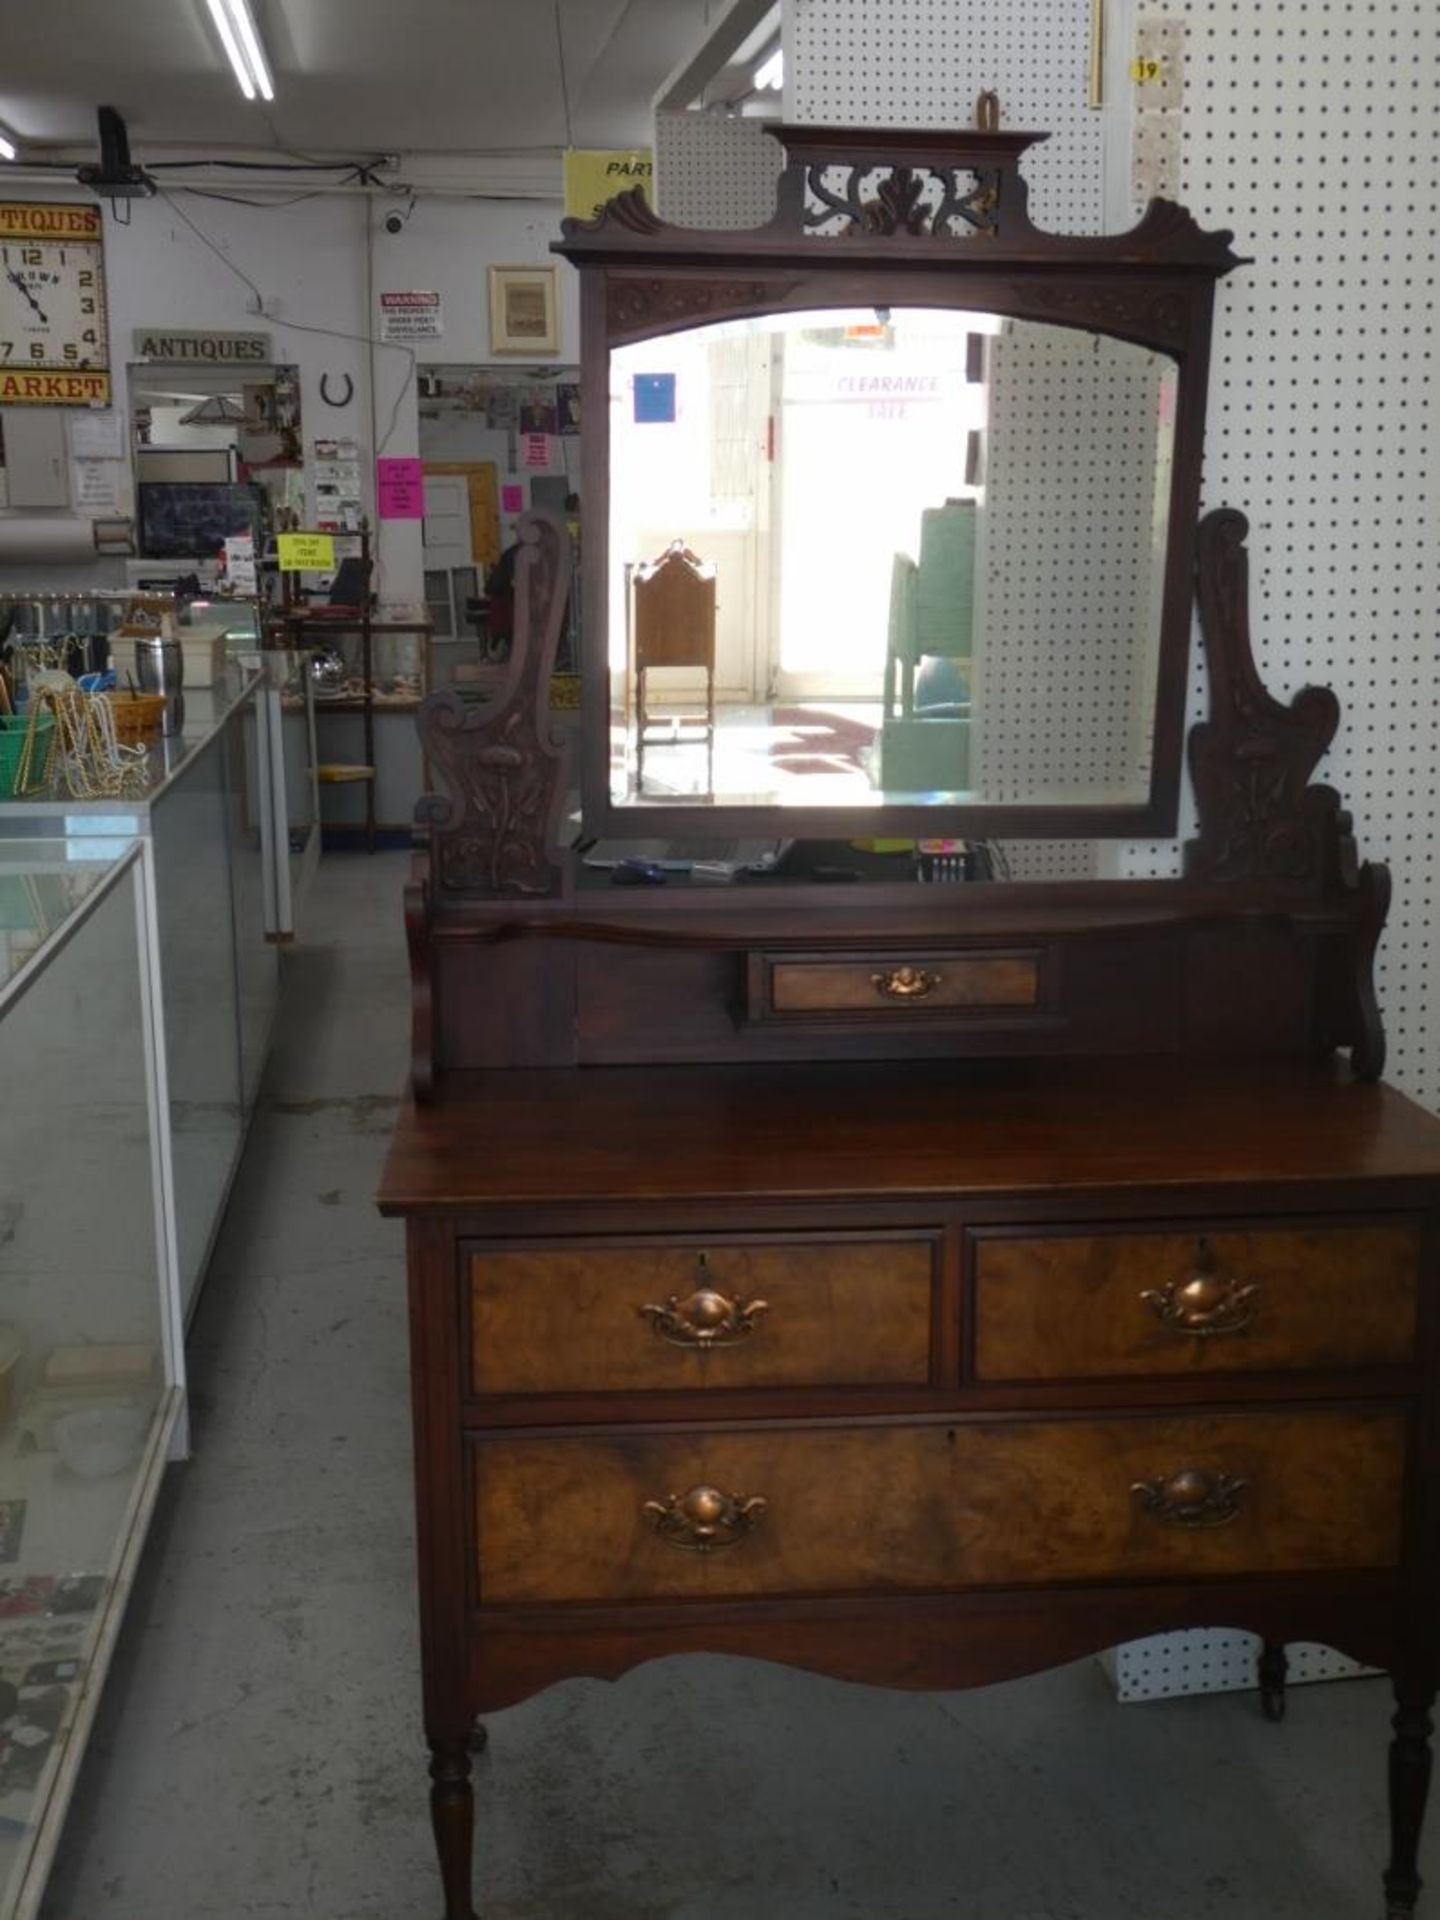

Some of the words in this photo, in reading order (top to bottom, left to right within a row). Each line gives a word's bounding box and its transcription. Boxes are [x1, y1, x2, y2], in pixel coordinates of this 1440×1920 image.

[1138, 61, 1157, 79] 19
[22, 249, 42, 265] 12
[79, 271, 93, 287] 2
[81, 298, 95, 314] 3
[82, 328, 97, 345] 4
[0, 341, 14, 358] 7
[30, 342, 45, 359] 6
[63, 343, 77, 359] 5
[142, 337, 265, 361] ANTIQUES
[2, 375, 104, 398] ARKET
[837, 376, 940, 392] CLEARANCE
